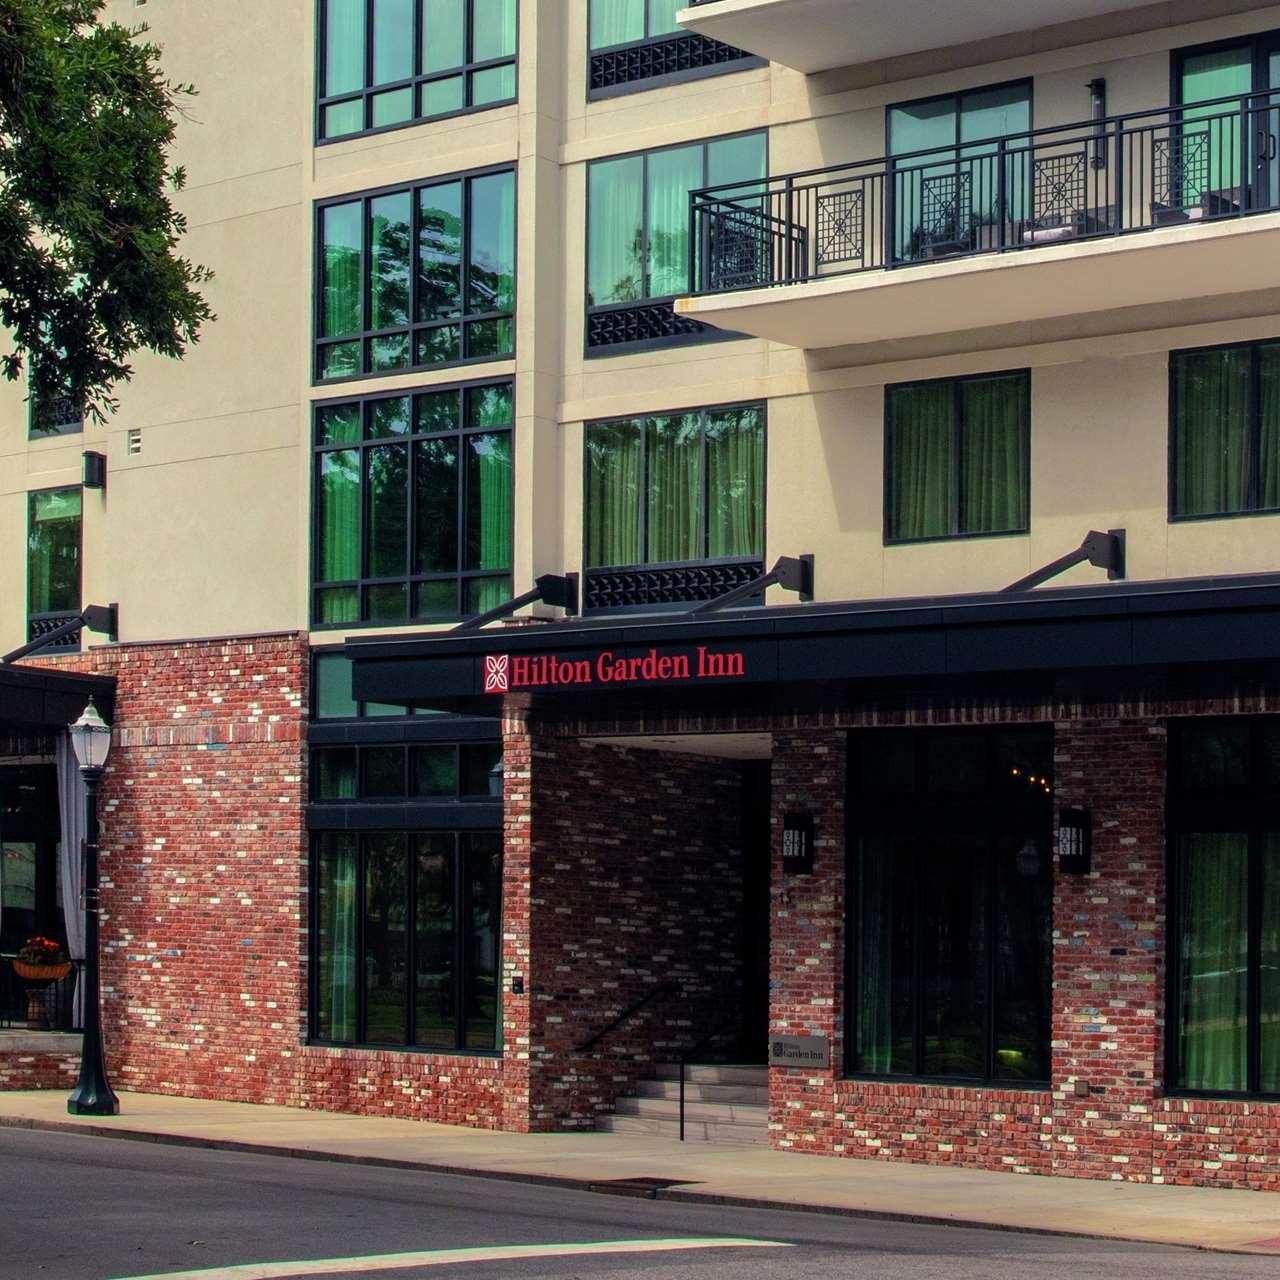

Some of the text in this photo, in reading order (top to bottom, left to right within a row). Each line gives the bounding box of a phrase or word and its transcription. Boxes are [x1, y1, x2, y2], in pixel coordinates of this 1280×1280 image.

[511, 646, 745, 687] Hilton Garden Inn
